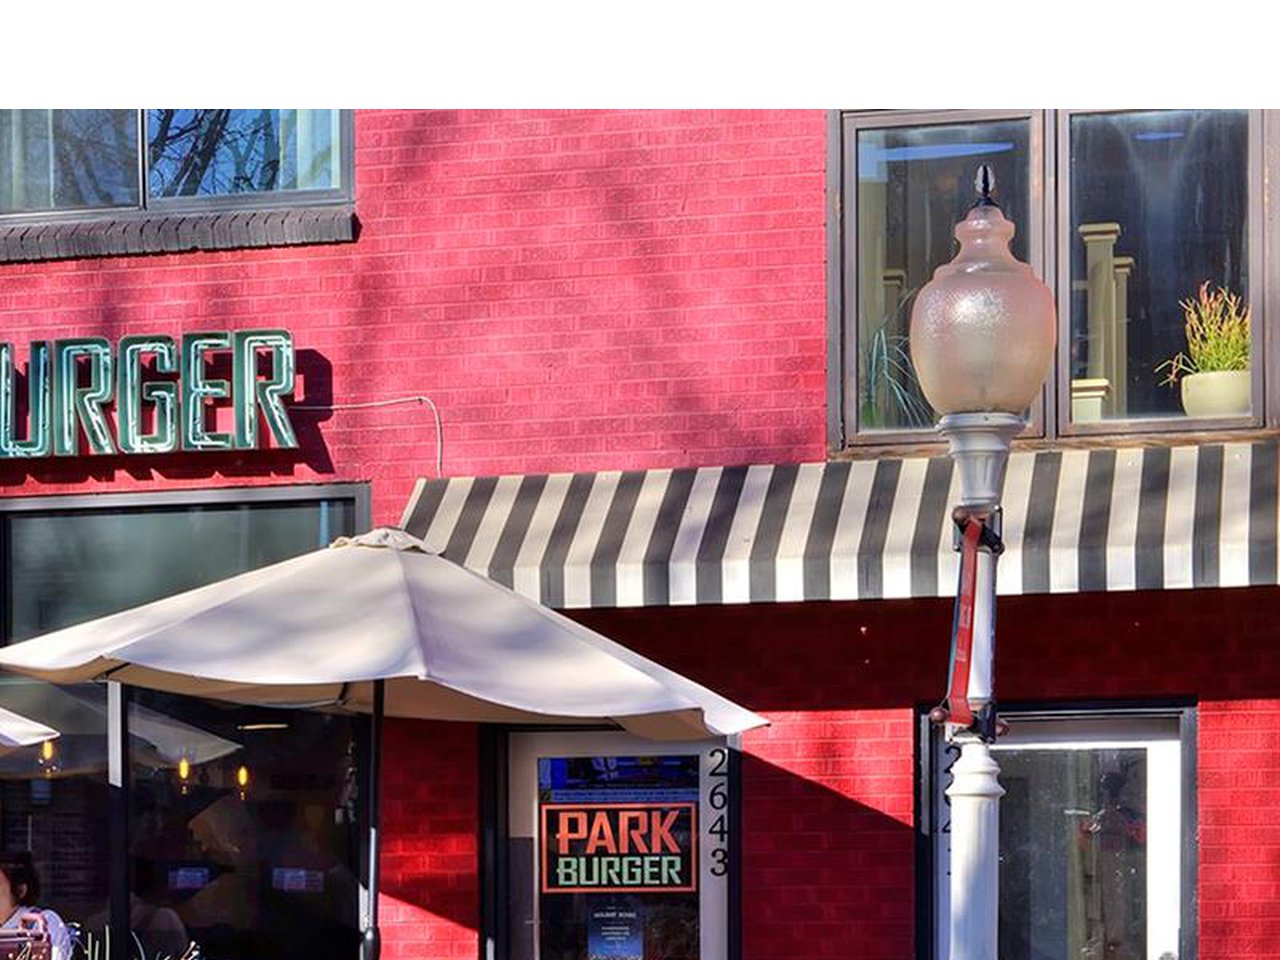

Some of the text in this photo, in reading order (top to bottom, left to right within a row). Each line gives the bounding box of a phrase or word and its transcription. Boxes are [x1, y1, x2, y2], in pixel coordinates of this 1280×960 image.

[556, 811, 682, 854] PARK
[708, 748, 729, 877] 2643
[556, 856, 682, 886] BURGER
